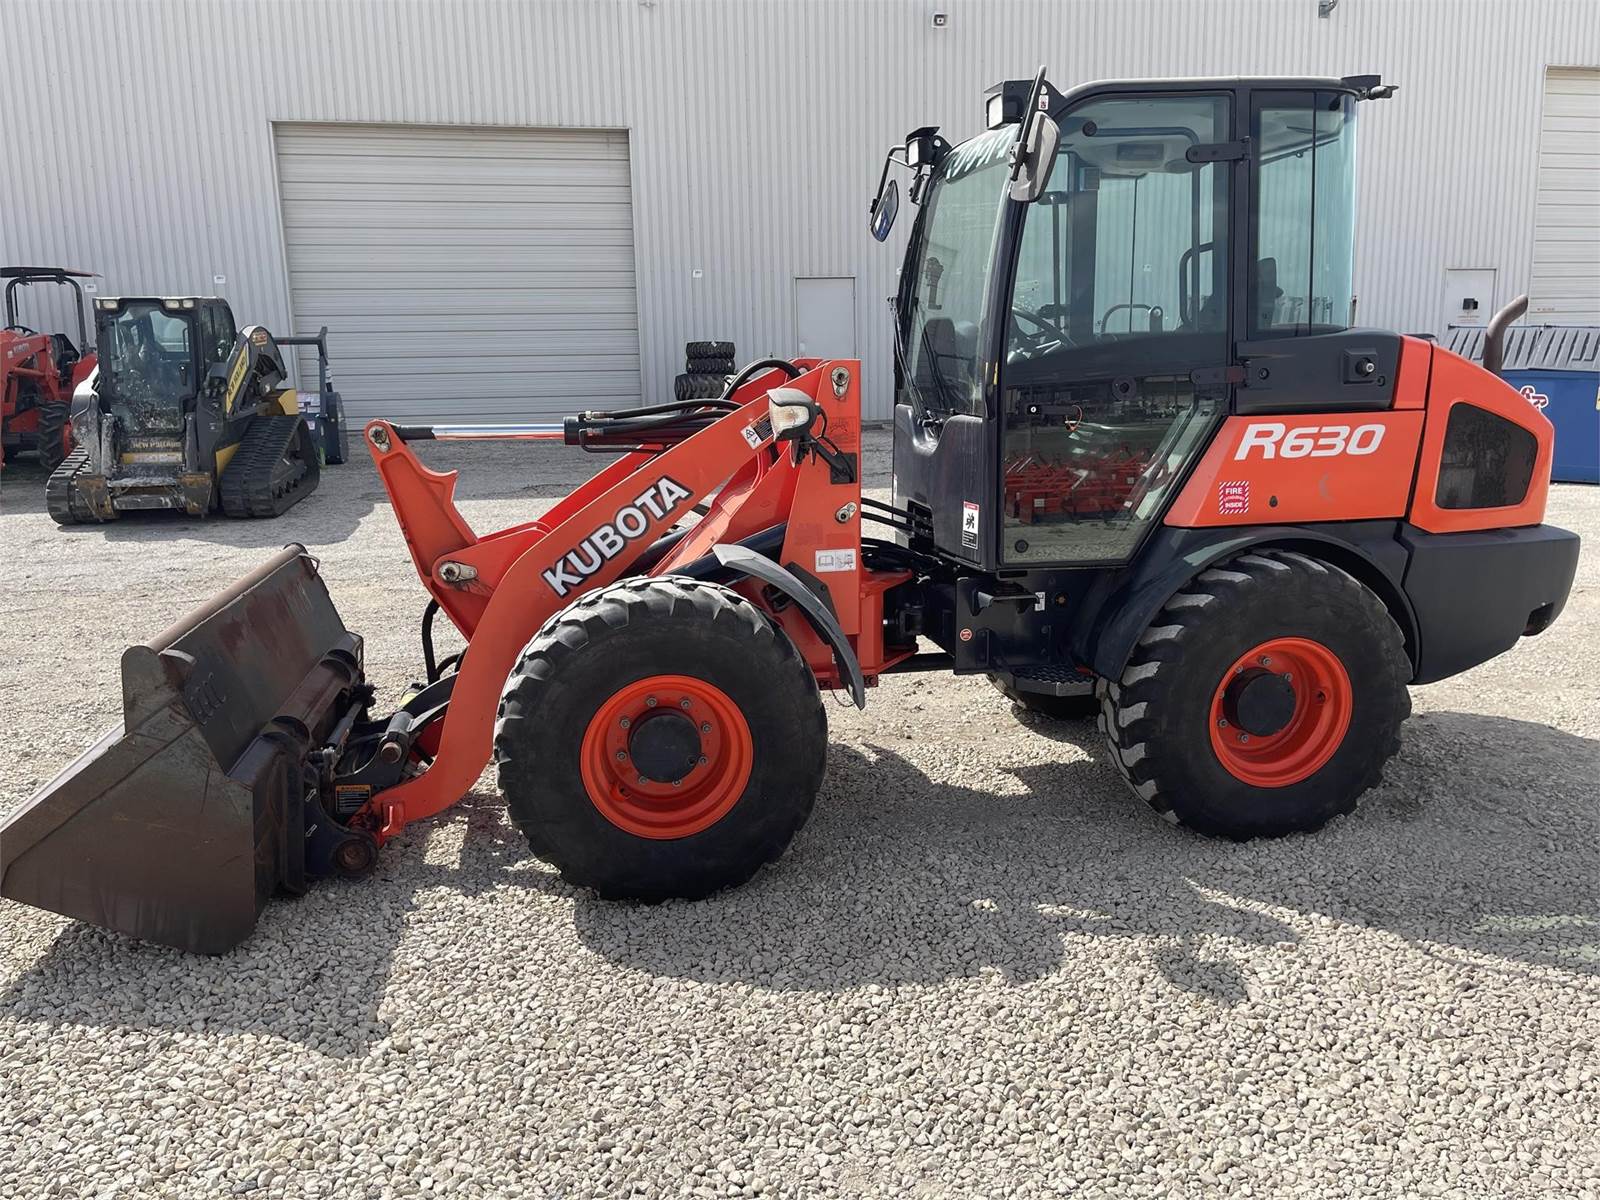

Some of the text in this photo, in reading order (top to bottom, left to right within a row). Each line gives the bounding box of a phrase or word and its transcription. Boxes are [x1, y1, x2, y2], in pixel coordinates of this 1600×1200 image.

[1234, 422, 1386, 460] R630
[1225, 486, 1243, 495] FIRE
[542, 476, 692, 597] KUBOTA
